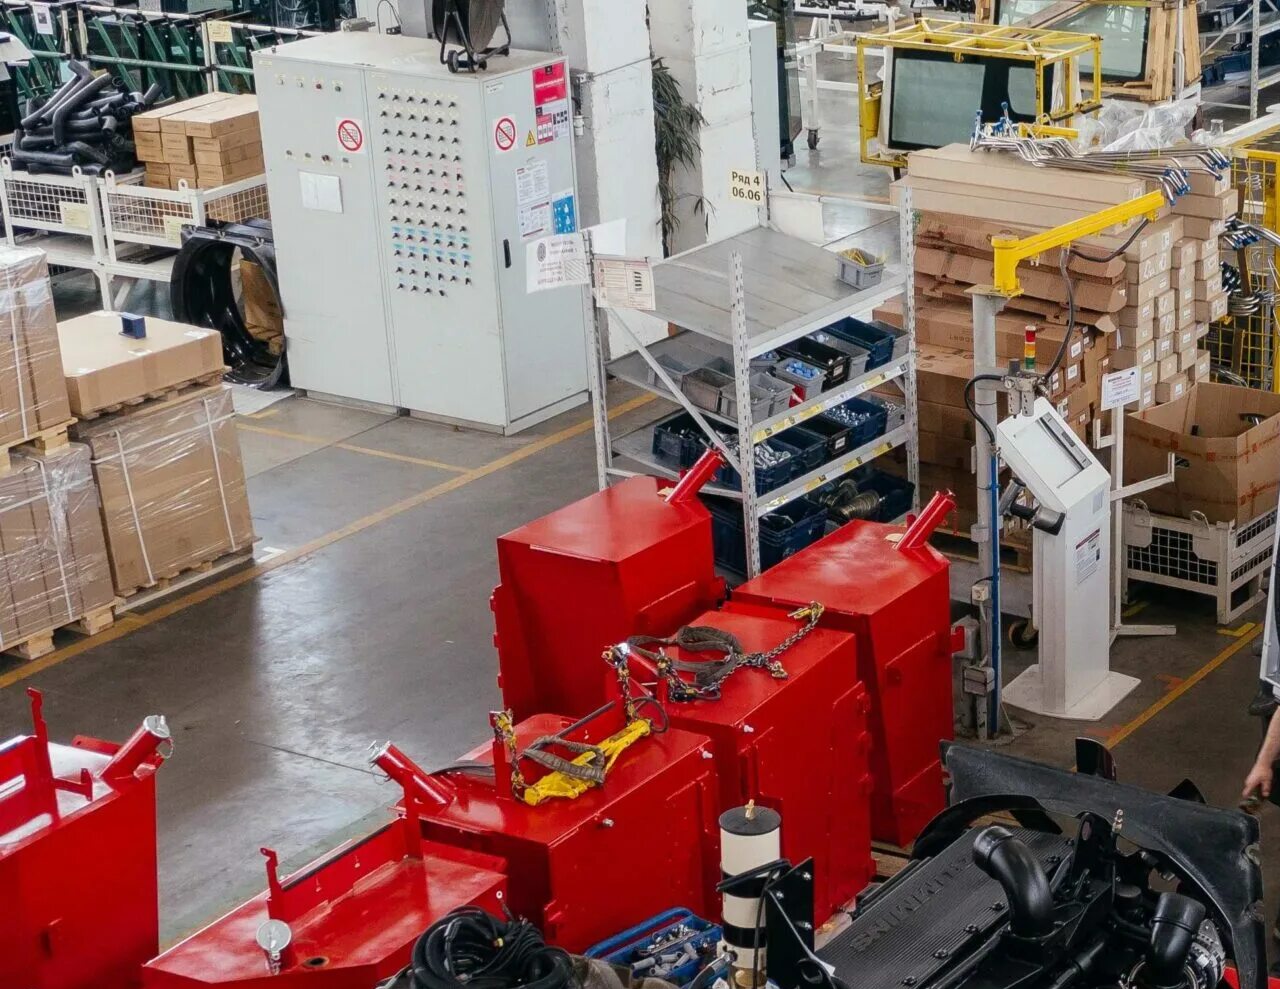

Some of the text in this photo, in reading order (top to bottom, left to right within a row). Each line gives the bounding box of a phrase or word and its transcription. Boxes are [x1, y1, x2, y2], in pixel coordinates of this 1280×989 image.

[731, 171, 760, 186] Ряд 4
[732, 186, 761, 201] 06.06
